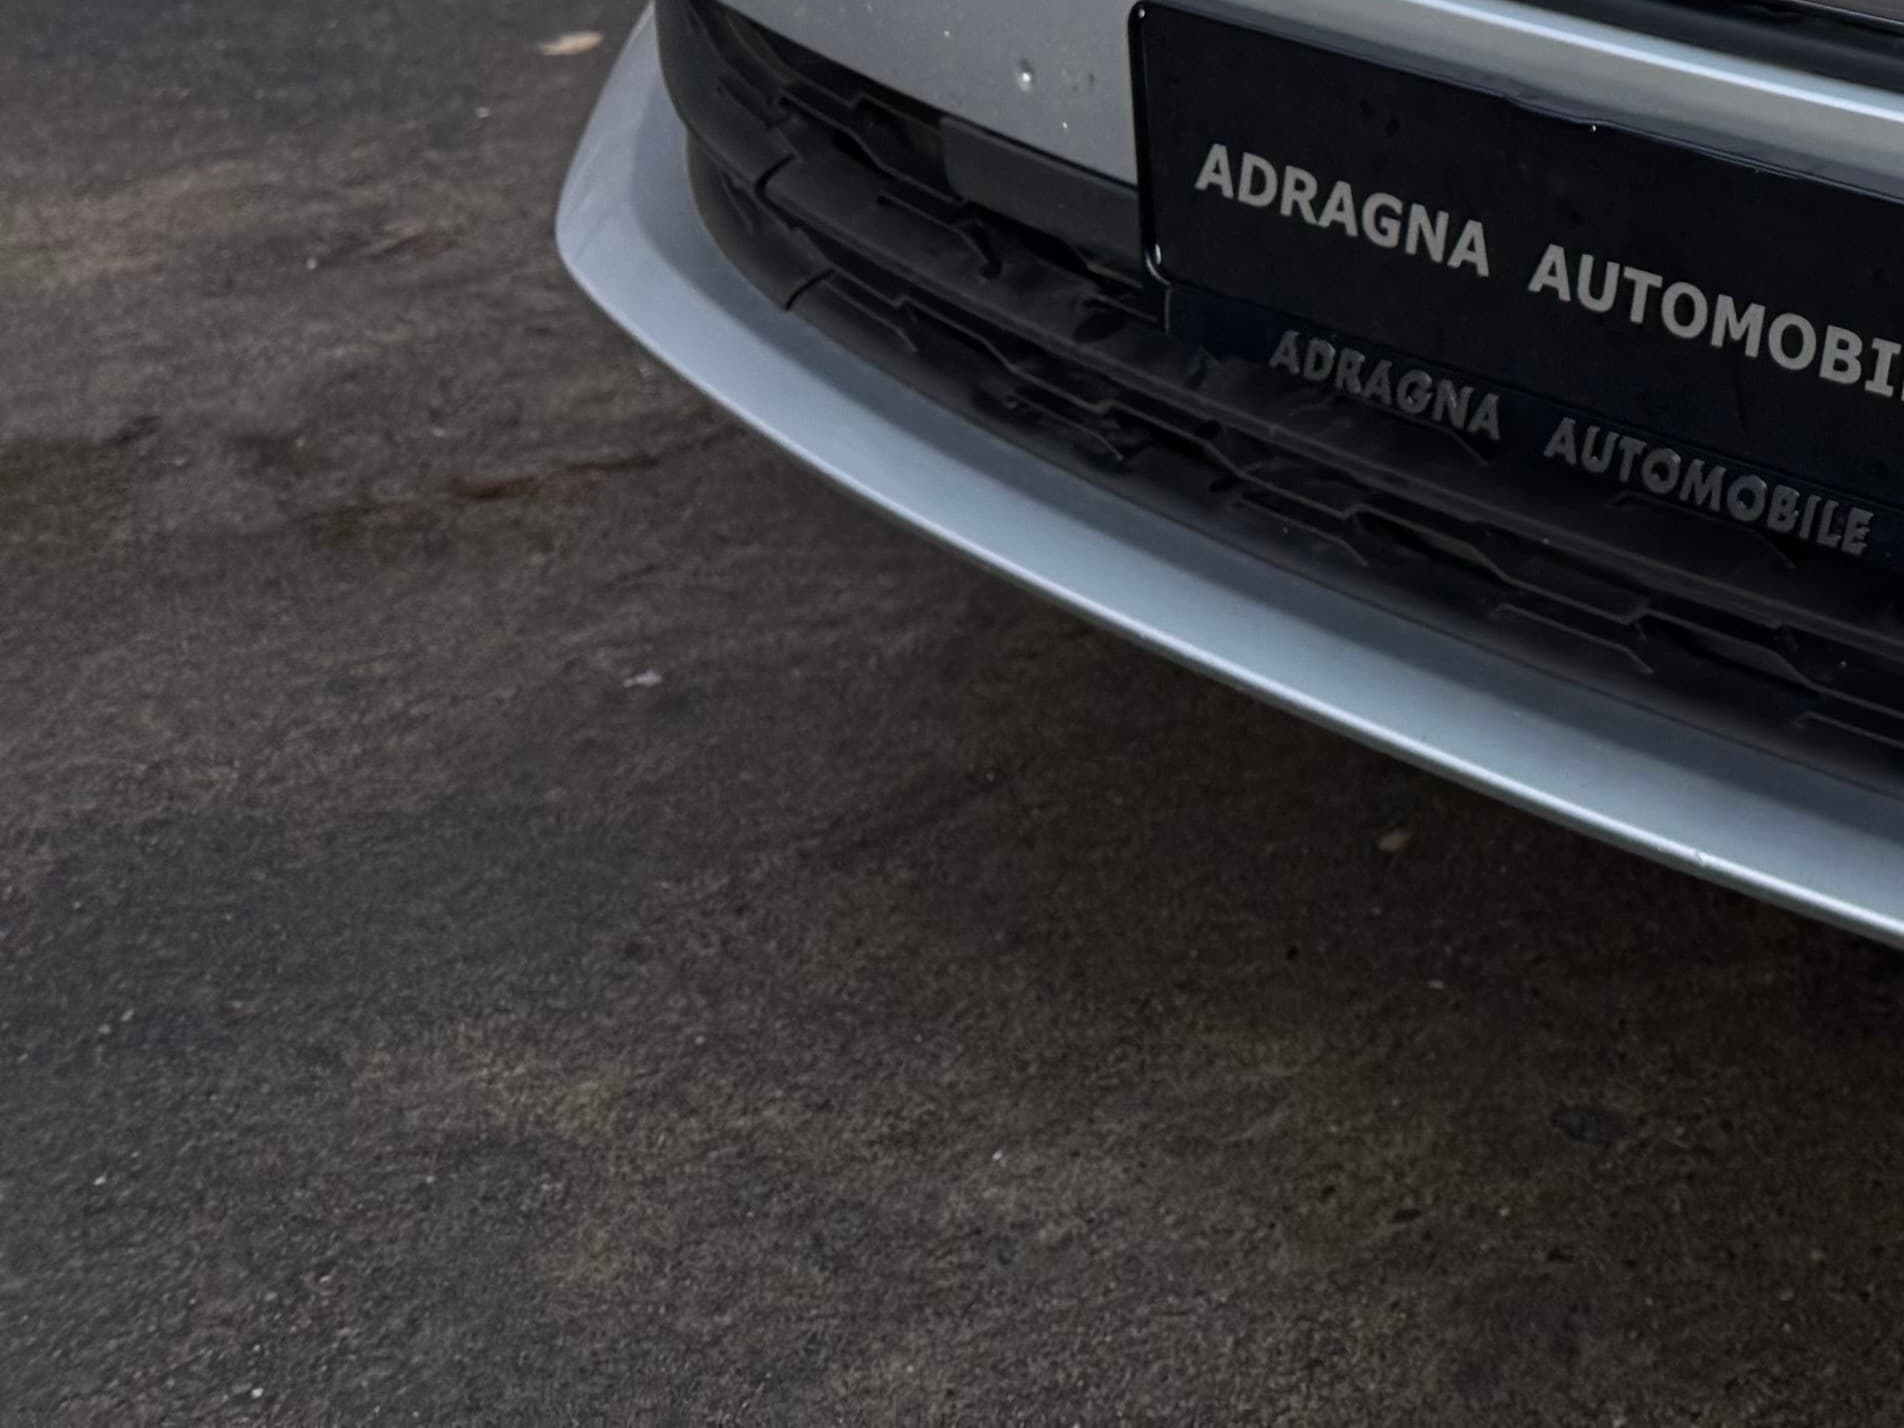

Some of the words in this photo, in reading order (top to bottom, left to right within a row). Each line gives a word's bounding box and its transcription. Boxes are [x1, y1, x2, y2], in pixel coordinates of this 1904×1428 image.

[1194, 143, 1490, 278] ADRAGNA
[1269, 329, 1501, 442] ADRAGNA
[1543, 416, 1874, 556] AUTOMOBILE
